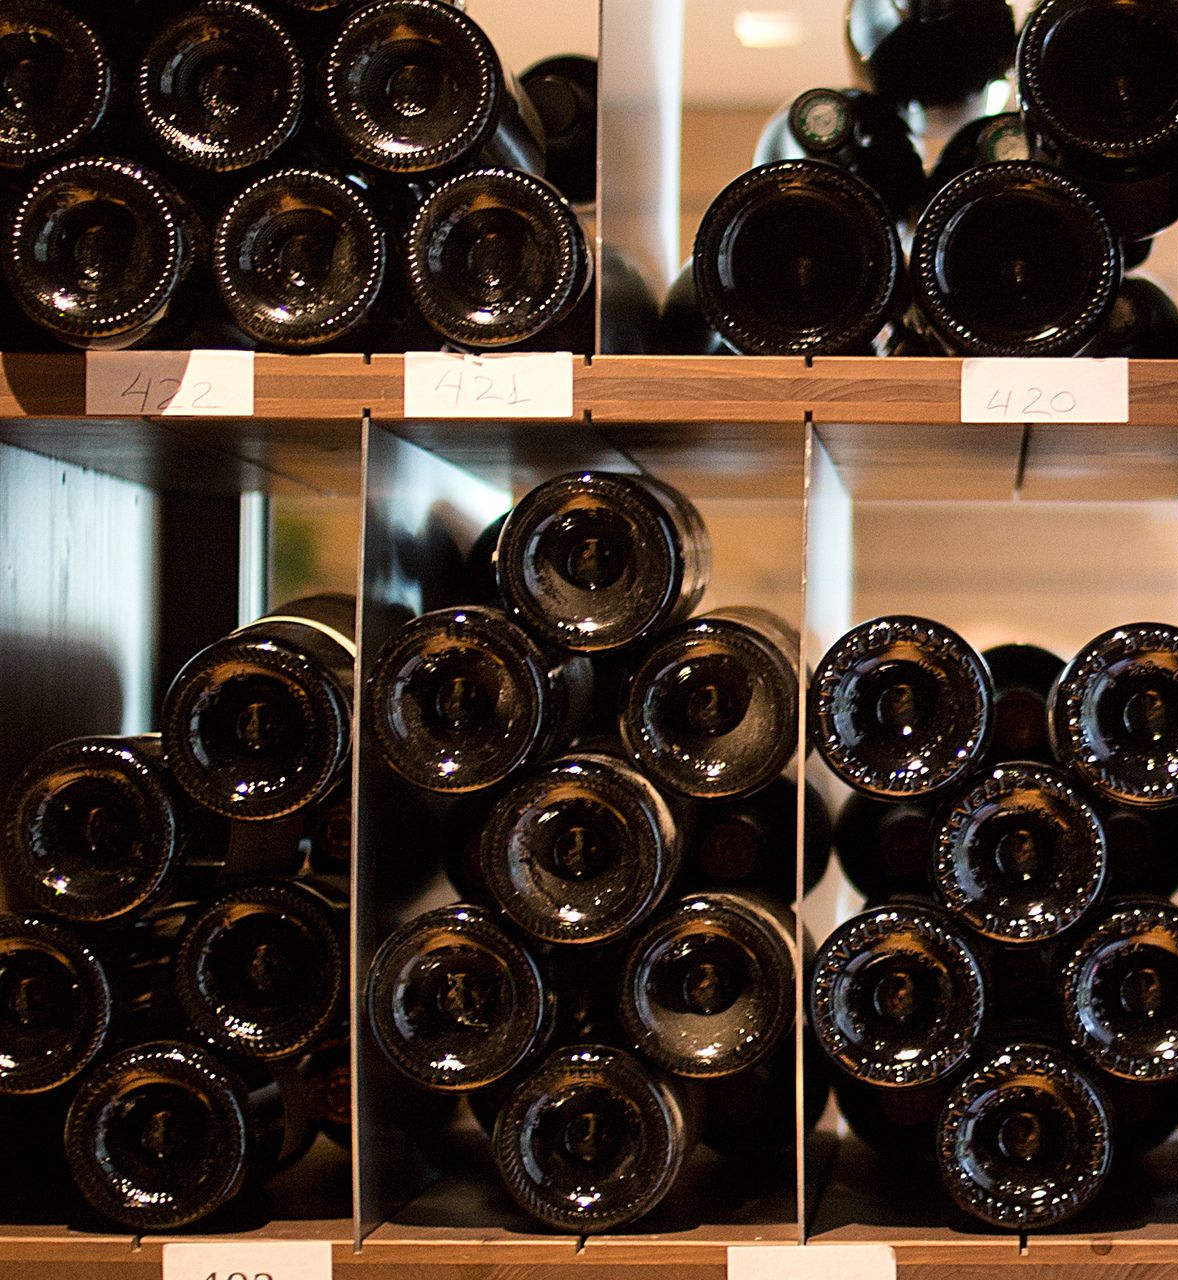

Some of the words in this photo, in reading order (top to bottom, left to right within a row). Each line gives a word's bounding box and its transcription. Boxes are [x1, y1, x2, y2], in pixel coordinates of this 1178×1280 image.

[120, 367, 225, 411] 422
[434, 368, 533, 405] 421
[986, 386, 1077, 419] 420
